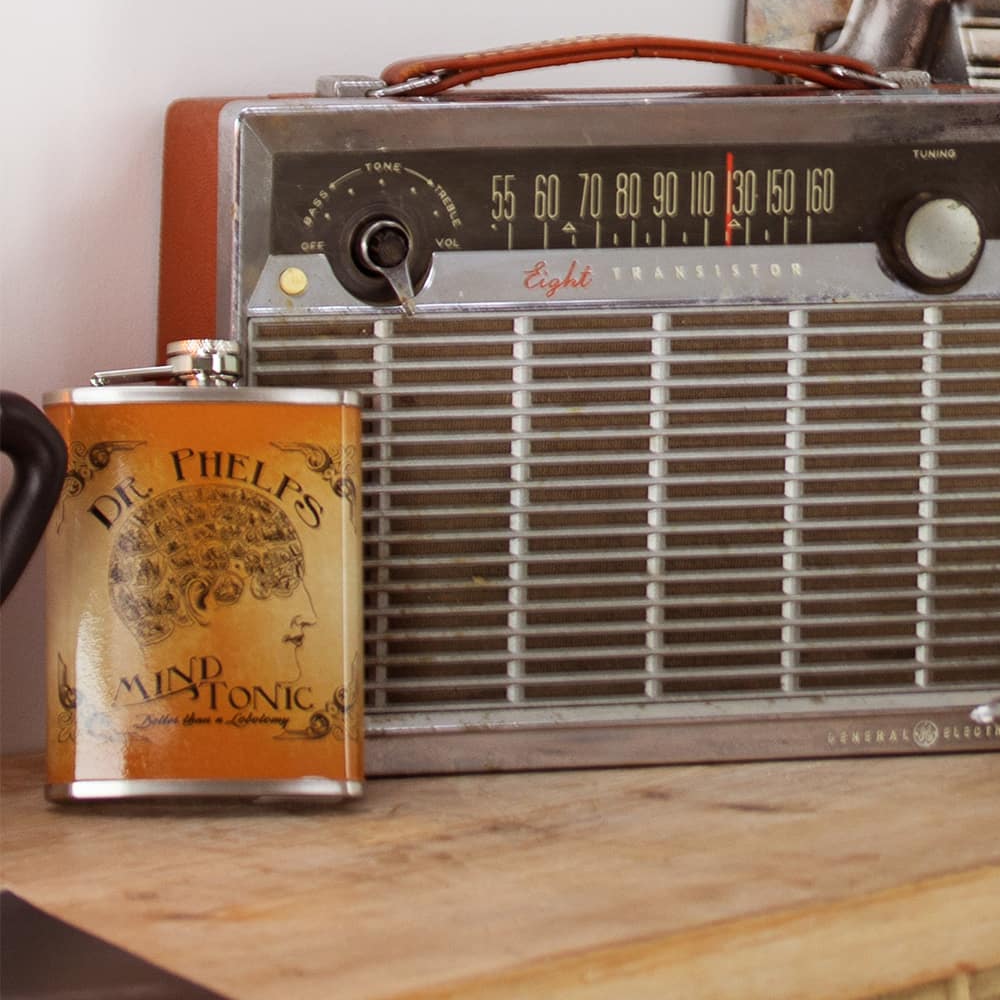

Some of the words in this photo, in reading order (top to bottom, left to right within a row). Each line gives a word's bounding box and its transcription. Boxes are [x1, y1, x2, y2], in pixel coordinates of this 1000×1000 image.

[364, 162, 402, 172] TONE
[912, 148, 957, 160] TUNING
[303, 190, 329, 227] BASS
[433, 183, 462, 228] TREBLE
[491, 174, 516, 220] 55
[534, 174, 561, 219] 60
[578, 172, 602, 218] 70
[615, 172, 642, 218] 80
[652, 171, 678, 218] 90
[690, 170, 715, 217] 110
[766, 169, 795, 216] 150
[806, 168, 835, 214] 160
[301, 240, 325, 251] OFF
[435, 238, 460, 249] VOL
[522, 259, 595, 297] Eight
[611, 263, 801, 281] TRANSISTOR
[87, 476, 153, 530] DR.
[169, 448, 323, 529] PHELPS
[112, 655, 222, 702] MIND
[199, 681, 313, 711] TONIC
[181, 712, 210, 726] than
[827, 728, 908, 745] GENERAL
